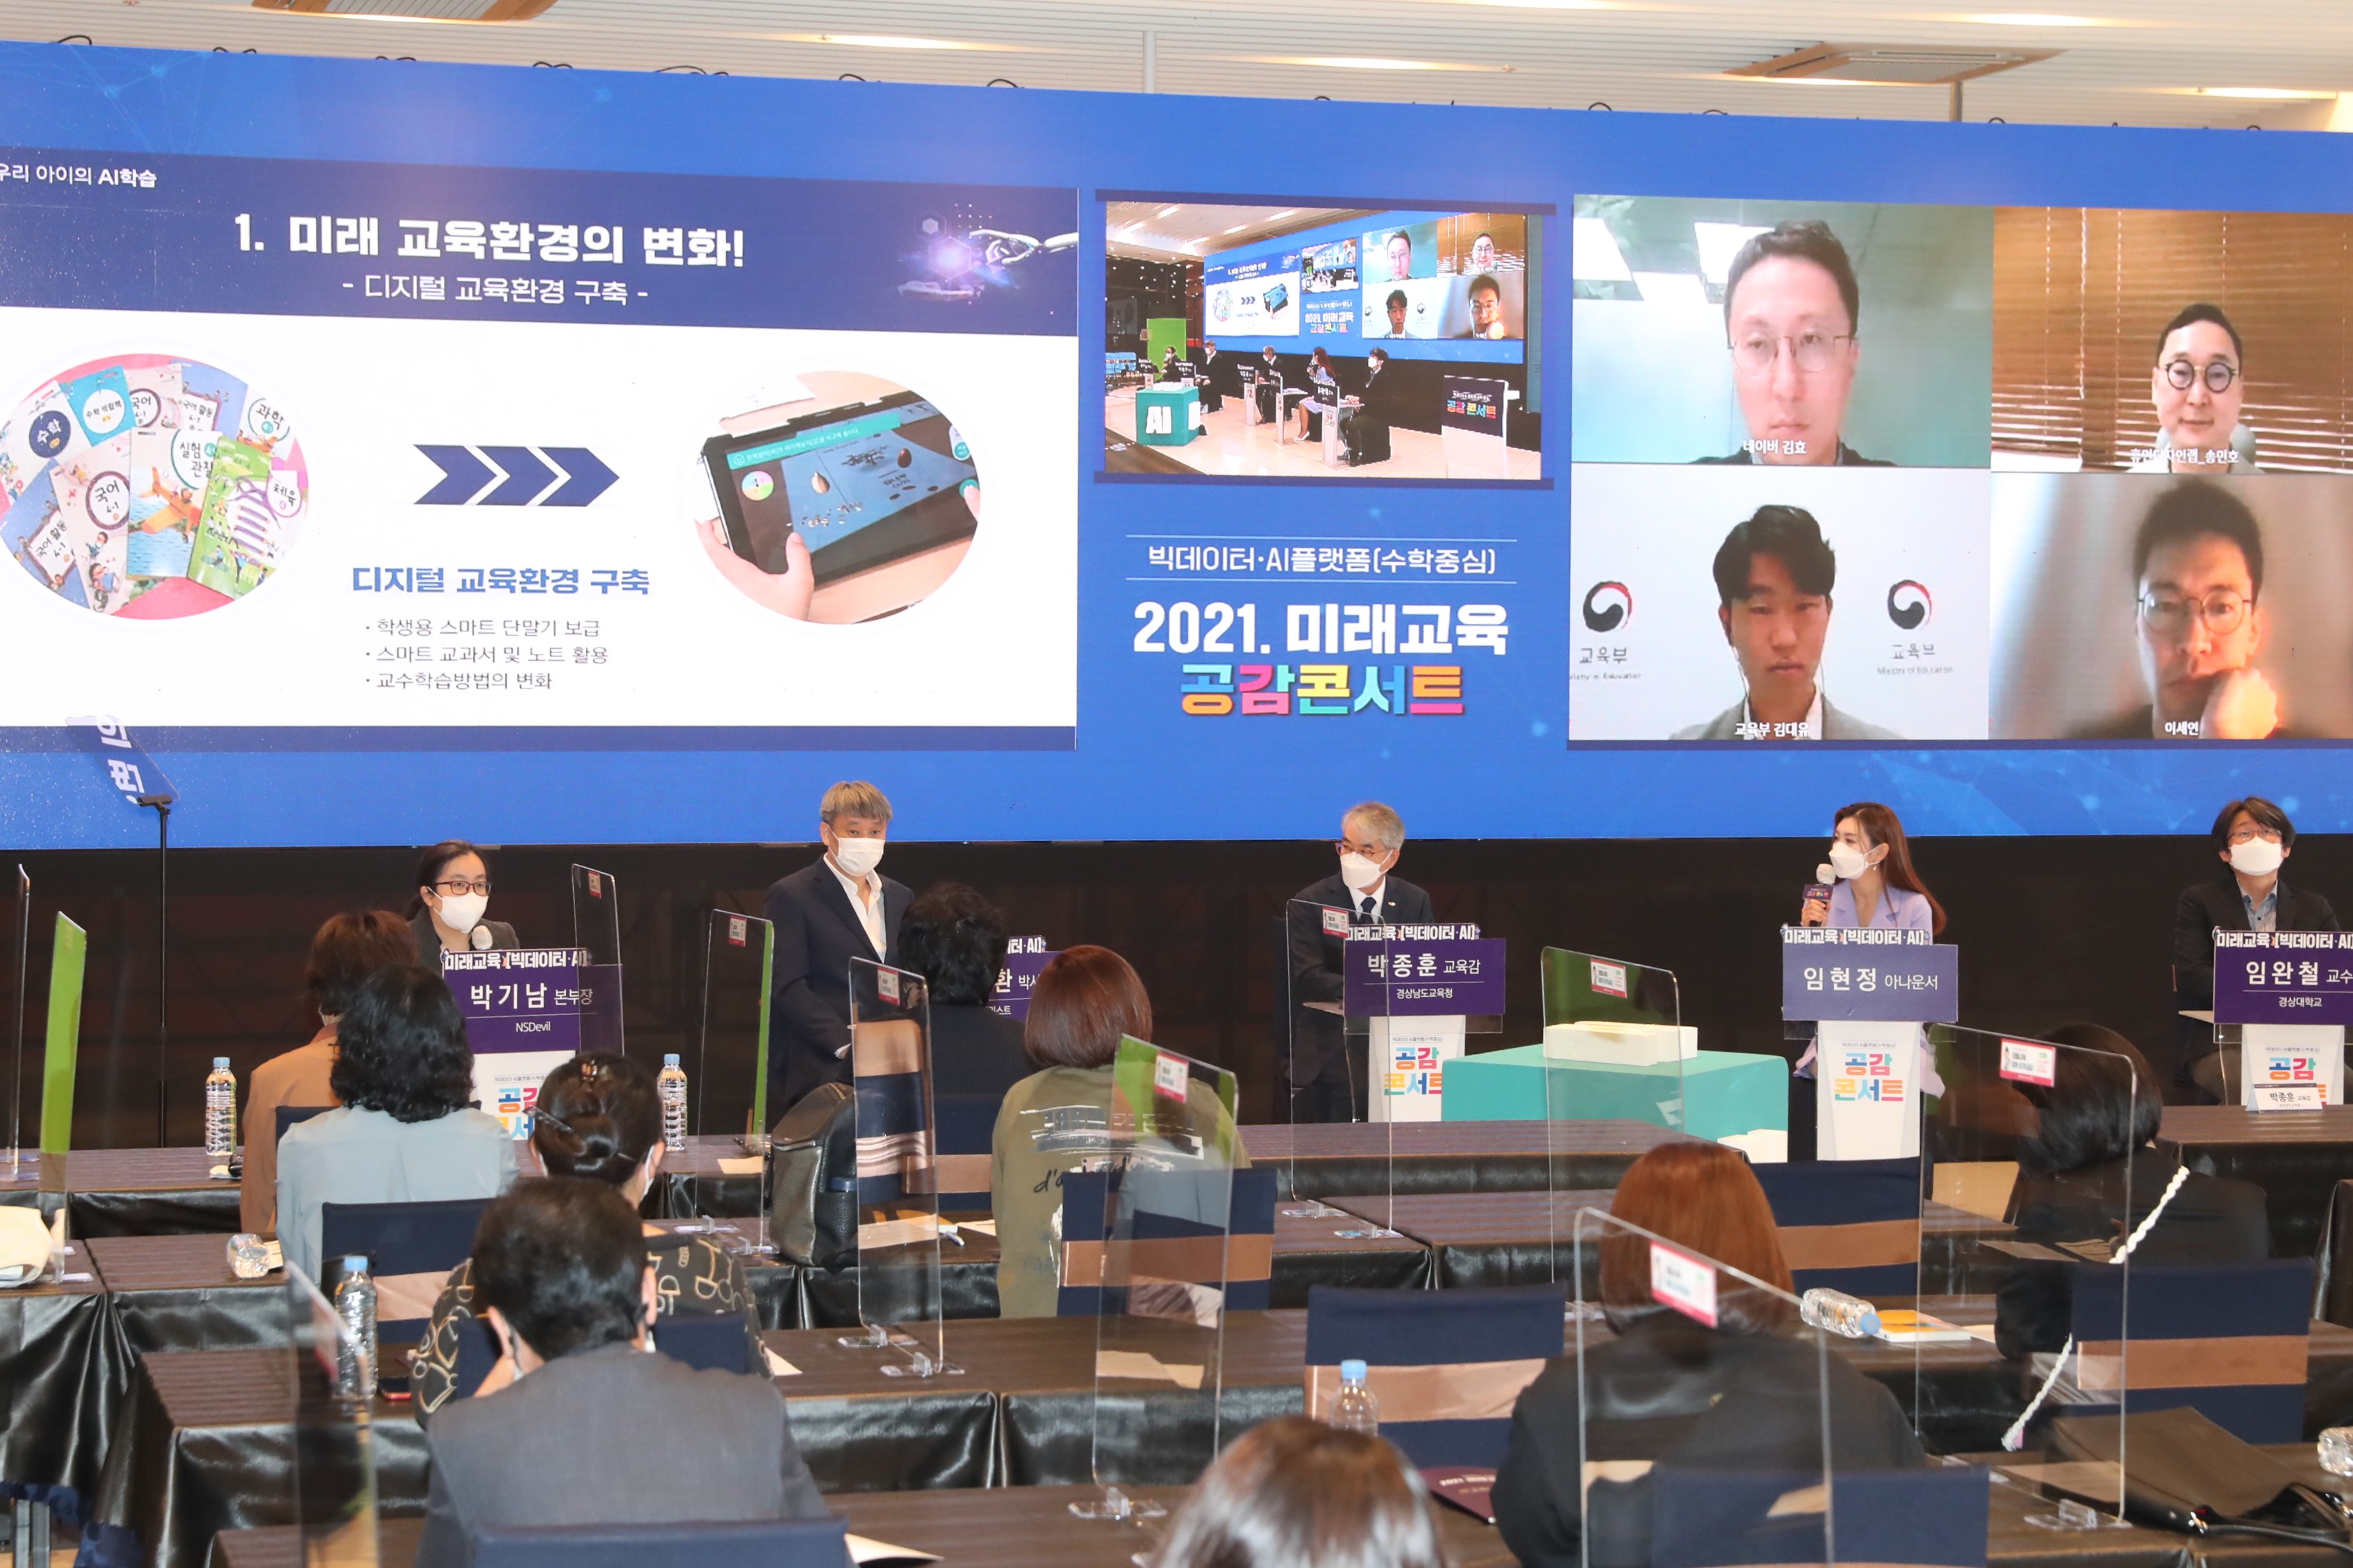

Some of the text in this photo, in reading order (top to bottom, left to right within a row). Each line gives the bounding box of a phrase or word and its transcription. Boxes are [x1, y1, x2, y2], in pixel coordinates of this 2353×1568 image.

[0, 163, 157, 188] 우리 아이의 AI학습
[234, 213, 744, 267] 1. 미래 교육환경의 변화!
[365, 274, 446, 301] 디지털
[455, 277, 565, 304] 교육환경
[574, 280, 628, 306] 구축
[256, 402, 285, 430] 과학
[1146, 406, 1172, 434] AI
[37, 418, 62, 444] 수학
[181, 441, 201, 459] 실험
[1742, 440, 1807, 456] 네이버 김효
[94, 479, 120, 503] 국어
[273, 483, 296, 507] 체육
[352, 566, 650, 595] 디지털 교육환경 구축
[377, 618, 601, 637] 학생용 스마트 단말기 보급
[1134, 602, 1508, 655] 2021. 미래교육
[376, 646, 609, 664] 스마트 교과서 및 노트 활용
[1579, 646, 1628, 665] 교육부
[376, 672, 552, 691] 교수학습방법의 변화
[1180, 663, 1464, 715] 공감콘서트
[1734, 721, 1810, 737] 교육부 김대유
[2164, 721, 2199, 736] 이세연
[1346, 925, 1396, 941] 미래교육
[1784, 930, 1838, 945] 미래교육
[2216, 933, 2270, 948] 미래교육
[445, 952, 502, 970] 미래교육
[1443, 958, 1481, 975] 교육감
[1884, 973, 1939, 991] 아나운서
[2325, 968, 2353, 984] 교수
[554, 988, 593, 1006] 본부장
[1396, 987, 1453, 999] 경상남도교육청
[2278, 996, 2322, 1007] 경상대학교
[515, 1021, 551, 1032] NSDevil
[1395, 1047, 1439, 1070] 공감
[1845, 1053, 1892, 1076] 공감
[2269, 1057, 2316, 1080] 공감
[1834, 1079, 1904, 1102] 콘서트
